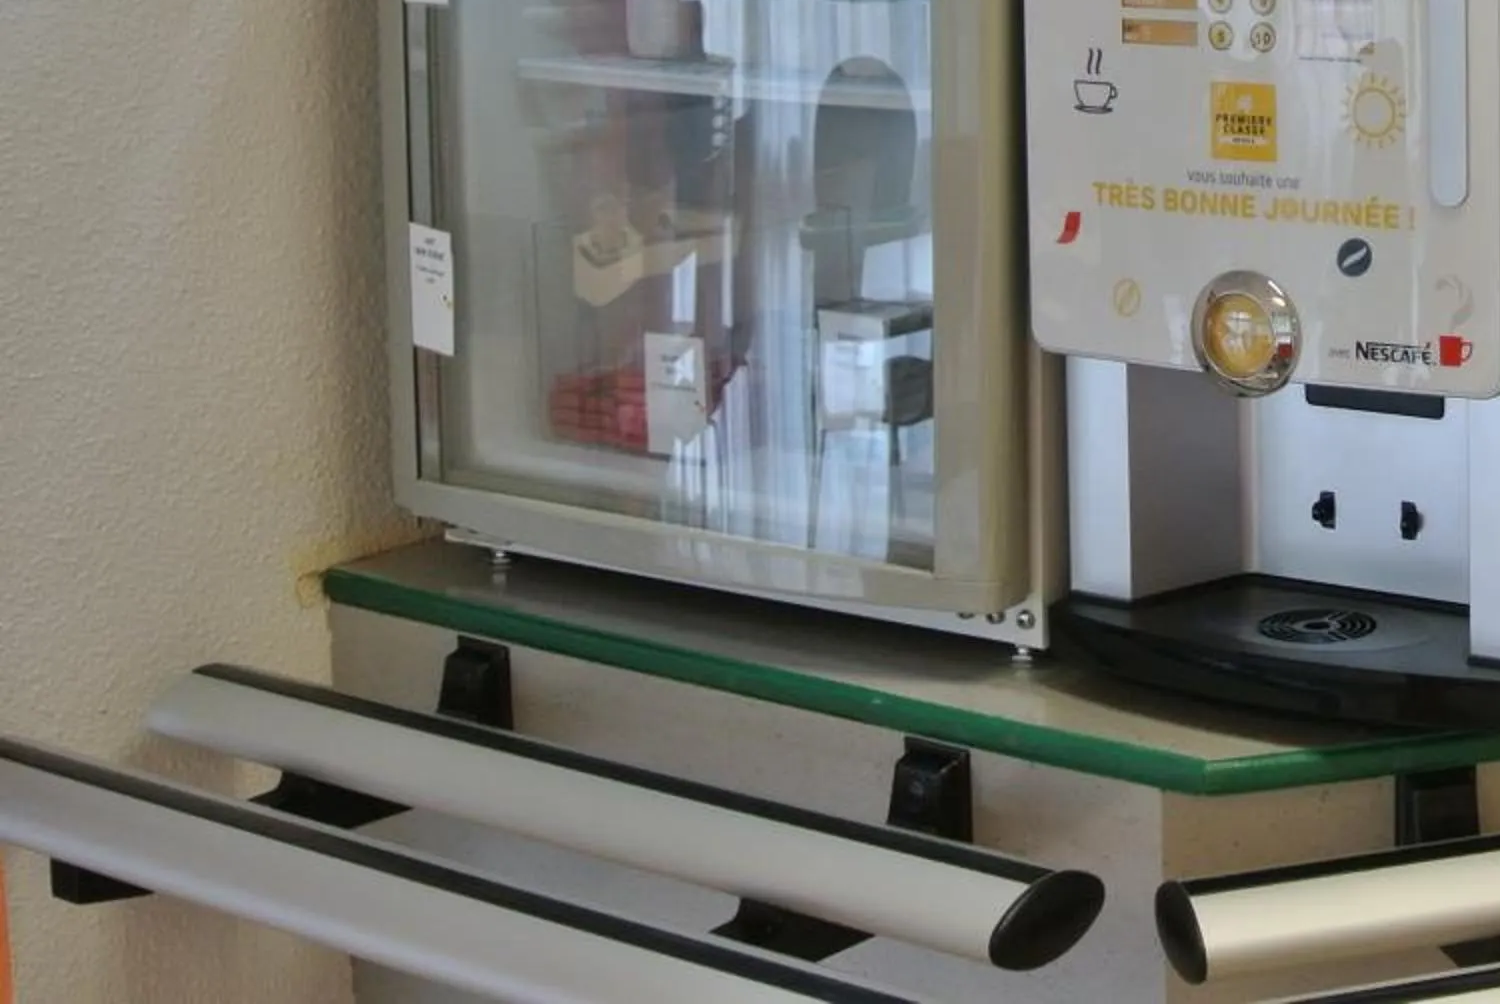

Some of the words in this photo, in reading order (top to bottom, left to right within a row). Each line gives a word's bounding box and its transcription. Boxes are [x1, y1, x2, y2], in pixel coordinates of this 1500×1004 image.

[1186, 168, 1216, 184] vous
[1218, 170, 1273, 190] souhaite
[1092, 177, 1156, 210] TRÈS
[1163, 187, 1257, 219] BONNE
[1263, 196, 1400, 230] JOURNÉE
[1354, 339, 1433, 366] NESCAFÉ
